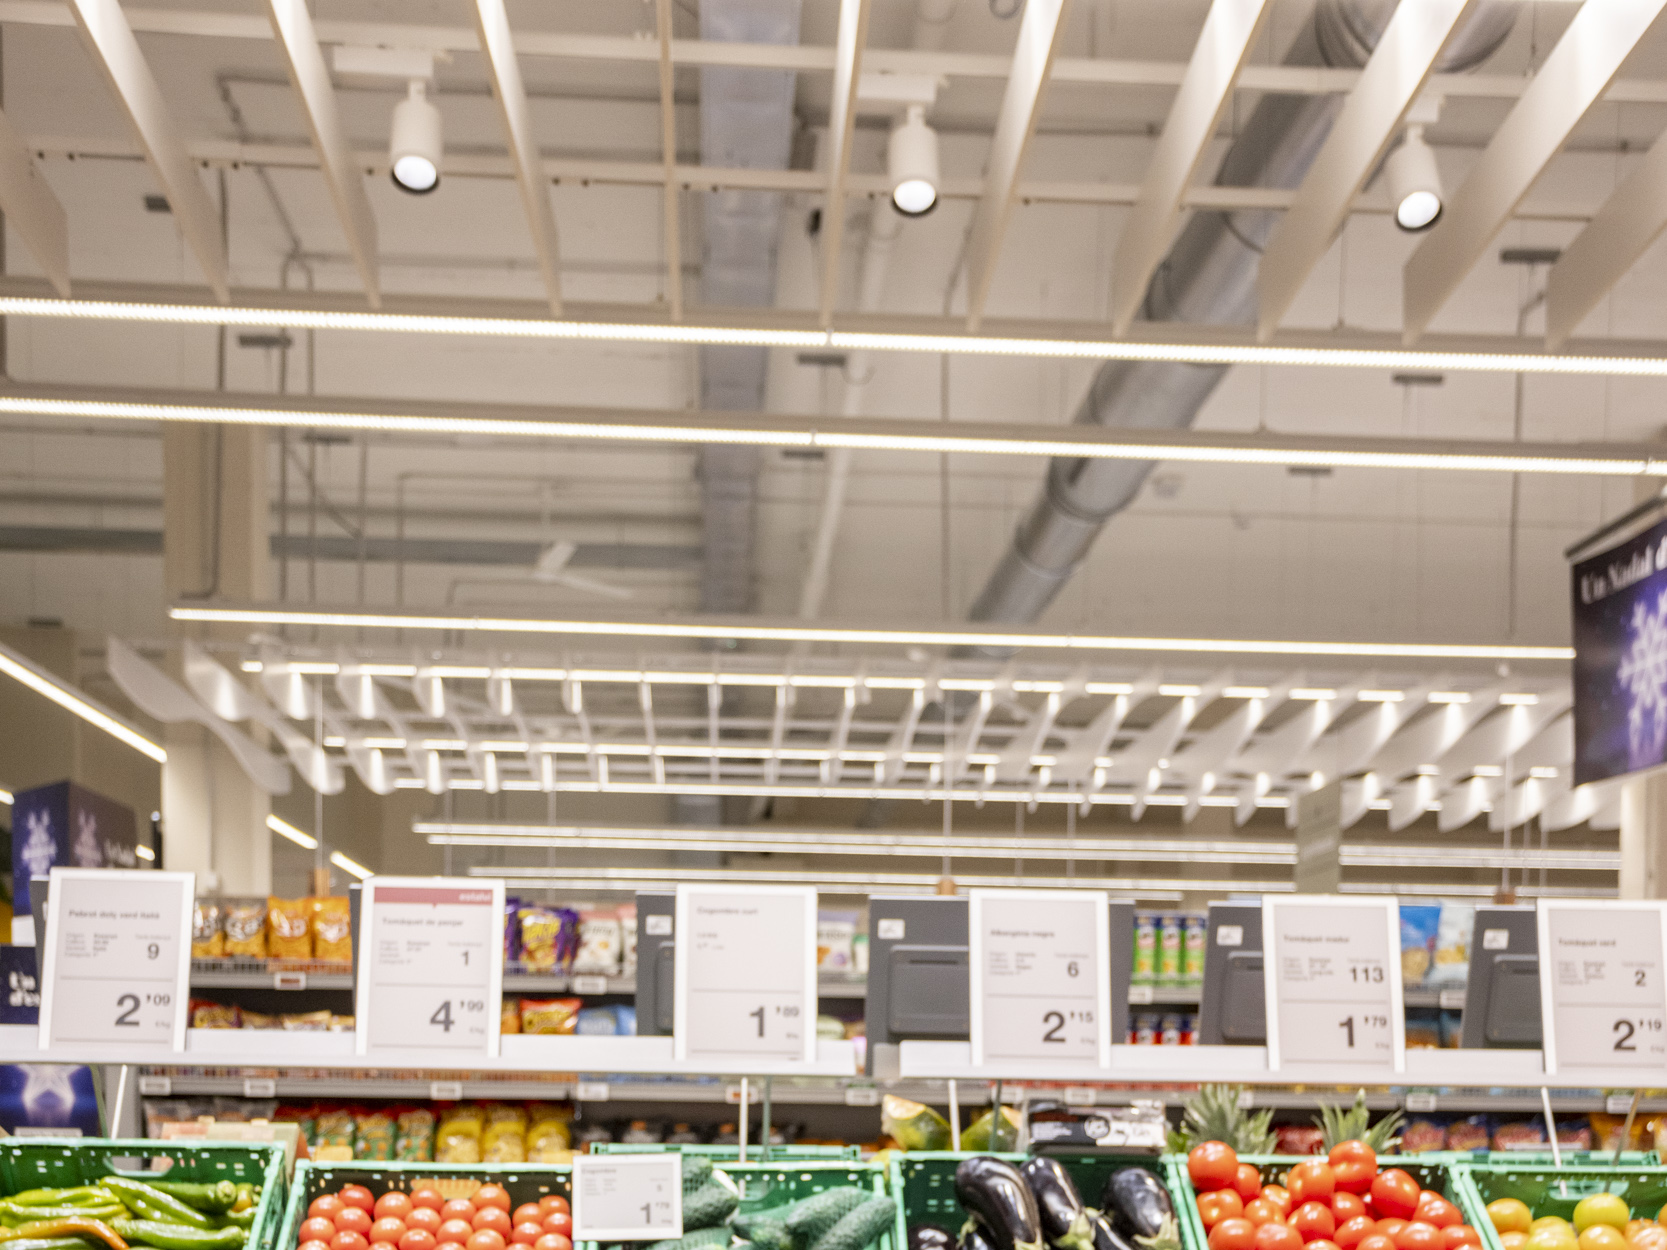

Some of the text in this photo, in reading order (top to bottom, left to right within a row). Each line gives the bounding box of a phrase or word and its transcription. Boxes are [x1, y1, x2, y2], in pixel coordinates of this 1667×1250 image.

[147, 943, 160, 960] 9
[461, 951, 470, 966] 1
[1067, 961, 1079, 978] 6
[1350, 967, 1384, 983] 113
[1635, 970, 1647, 987] 2
